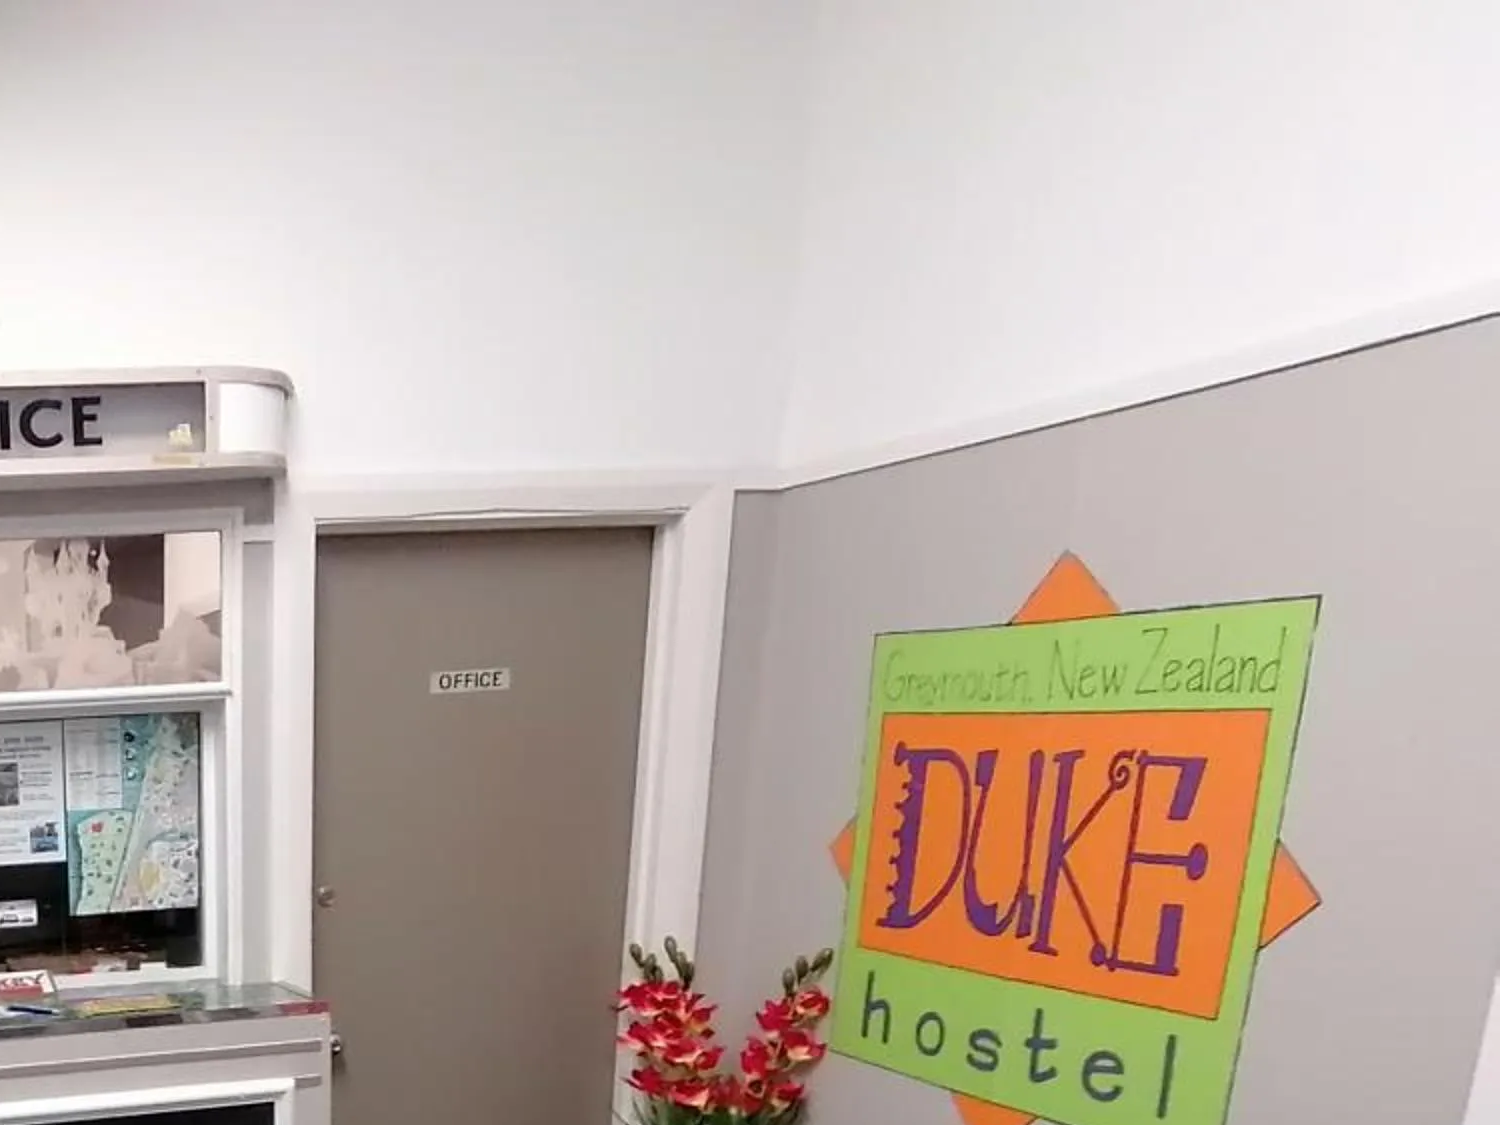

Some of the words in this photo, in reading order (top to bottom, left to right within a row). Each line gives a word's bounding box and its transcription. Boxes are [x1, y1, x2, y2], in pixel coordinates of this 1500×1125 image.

[439, 671, 503, 690] OFFICE
[1046, 638, 1129, 702] New
[1135, 624, 1288, 696] Zealand
[875, 741, 1209, 977] DUKE
[860, 971, 1177, 1119] hostel
